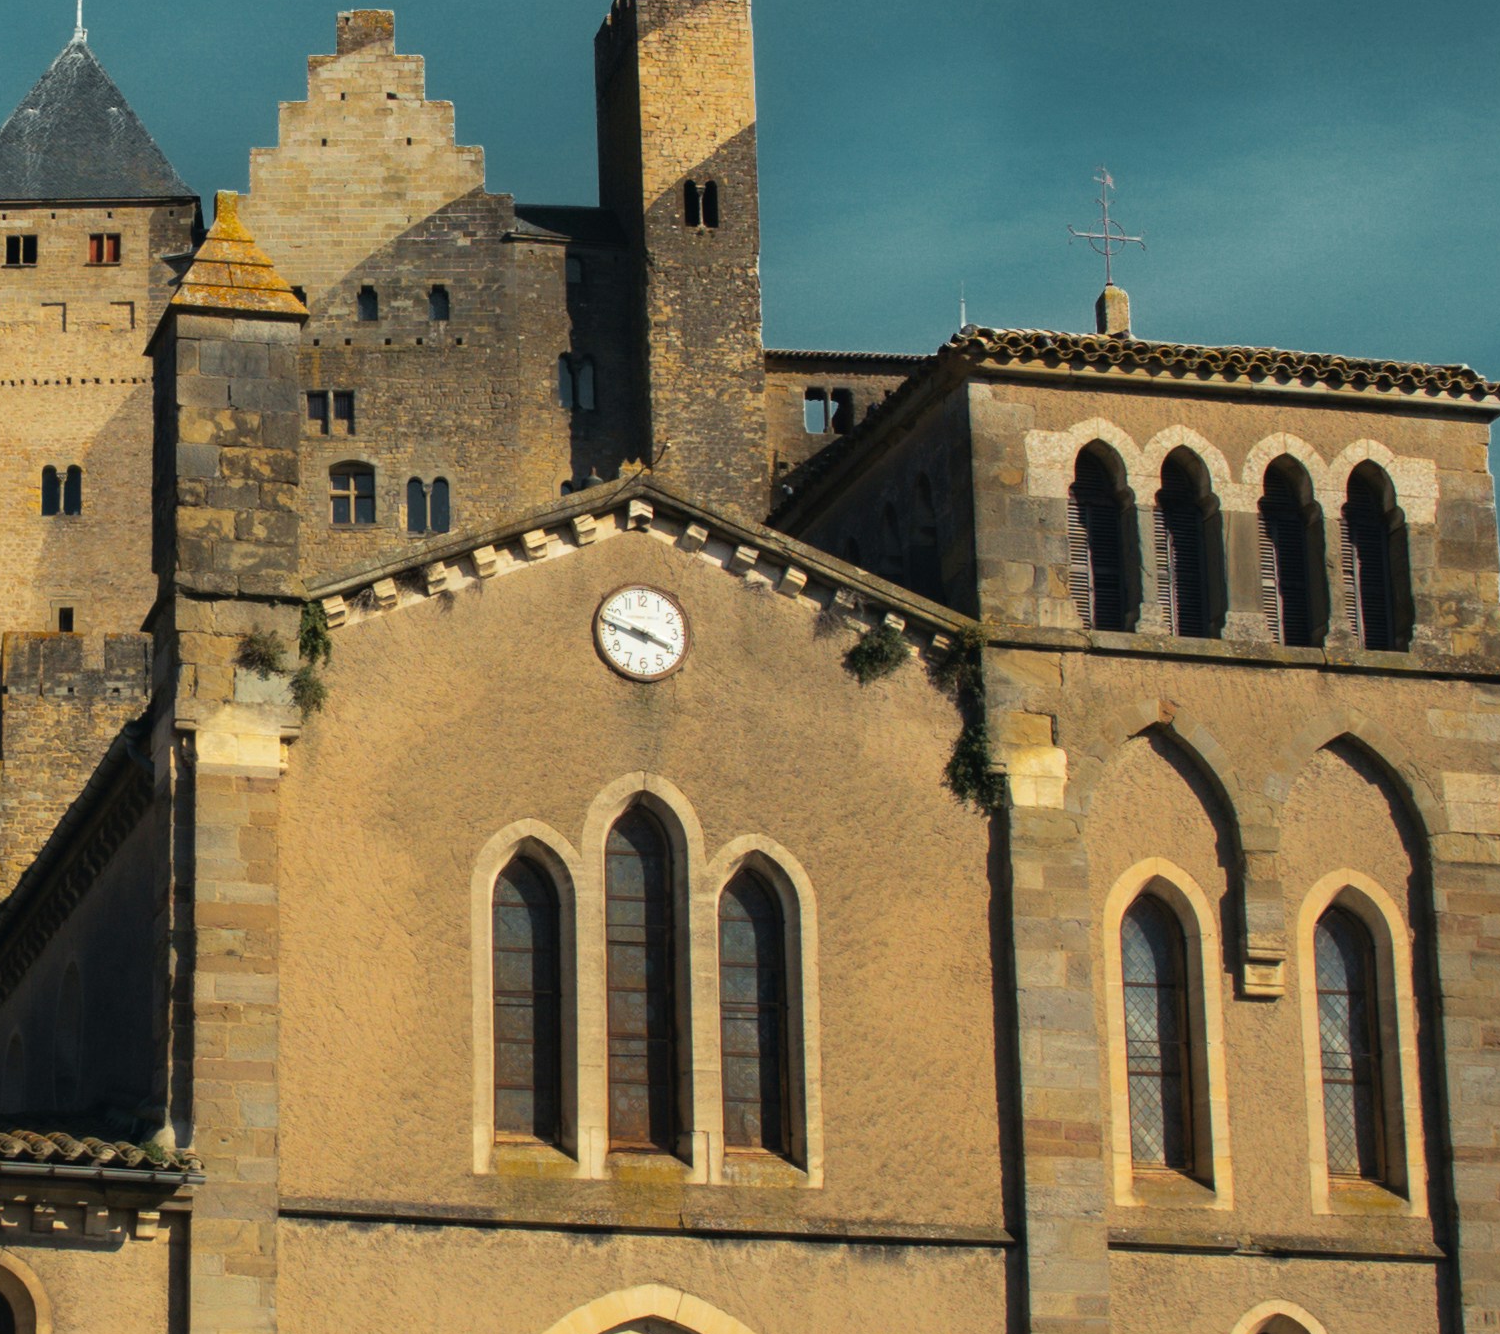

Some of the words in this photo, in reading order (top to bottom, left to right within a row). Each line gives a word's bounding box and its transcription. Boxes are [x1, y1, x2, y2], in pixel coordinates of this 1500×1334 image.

[625, 597, 631, 610] 11
[637, 594, 648, 608] 12
[665, 612, 674, 624] 2
[608, 623, 616, 635] 9
[671, 628, 678, 640] 3
[613, 639, 621, 651] 8
[666, 644, 674, 654] 4
[624, 651, 632, 667] 7
[639, 657, 648, 669] 6
[655, 654, 664, 666] 5
